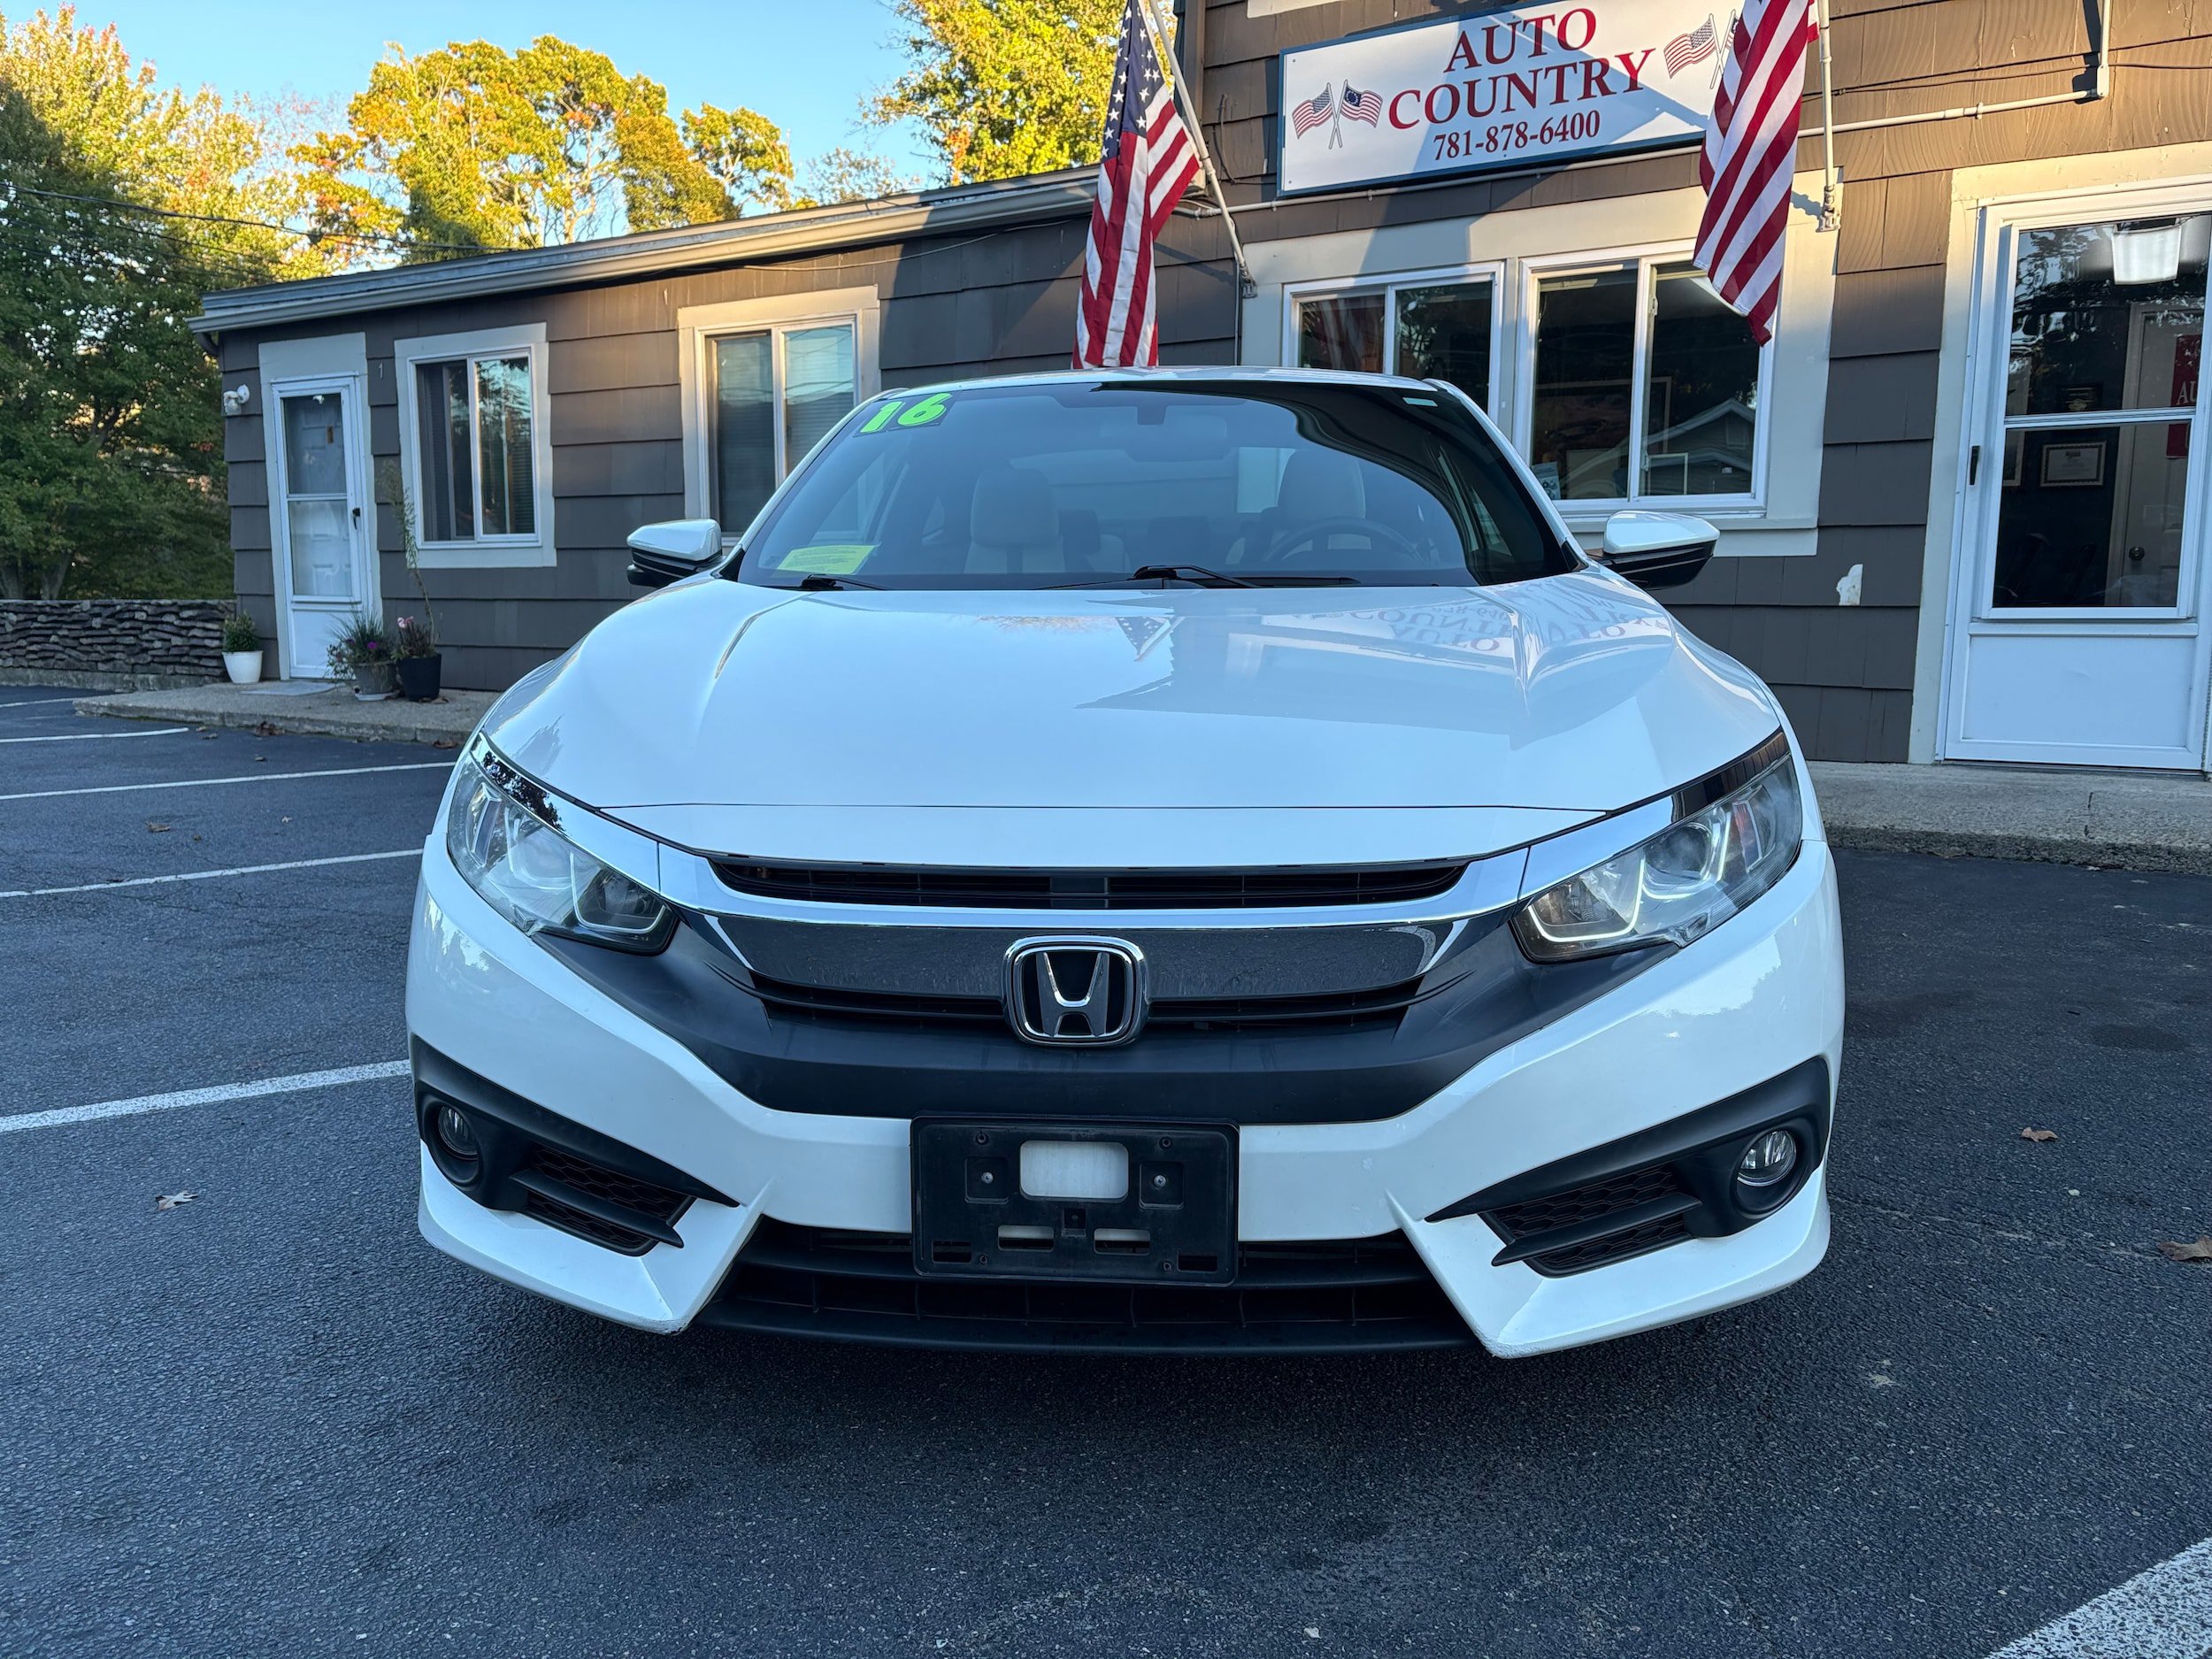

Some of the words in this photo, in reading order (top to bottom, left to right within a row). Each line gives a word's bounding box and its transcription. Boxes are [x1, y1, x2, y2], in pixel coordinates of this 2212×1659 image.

[1443, 8, 1597, 73] AUTO
[1388, 48, 1656, 130] COUNTRY
[1432, 110, 1601, 161] 781-878-6400
[860, 393, 952, 433] 16
